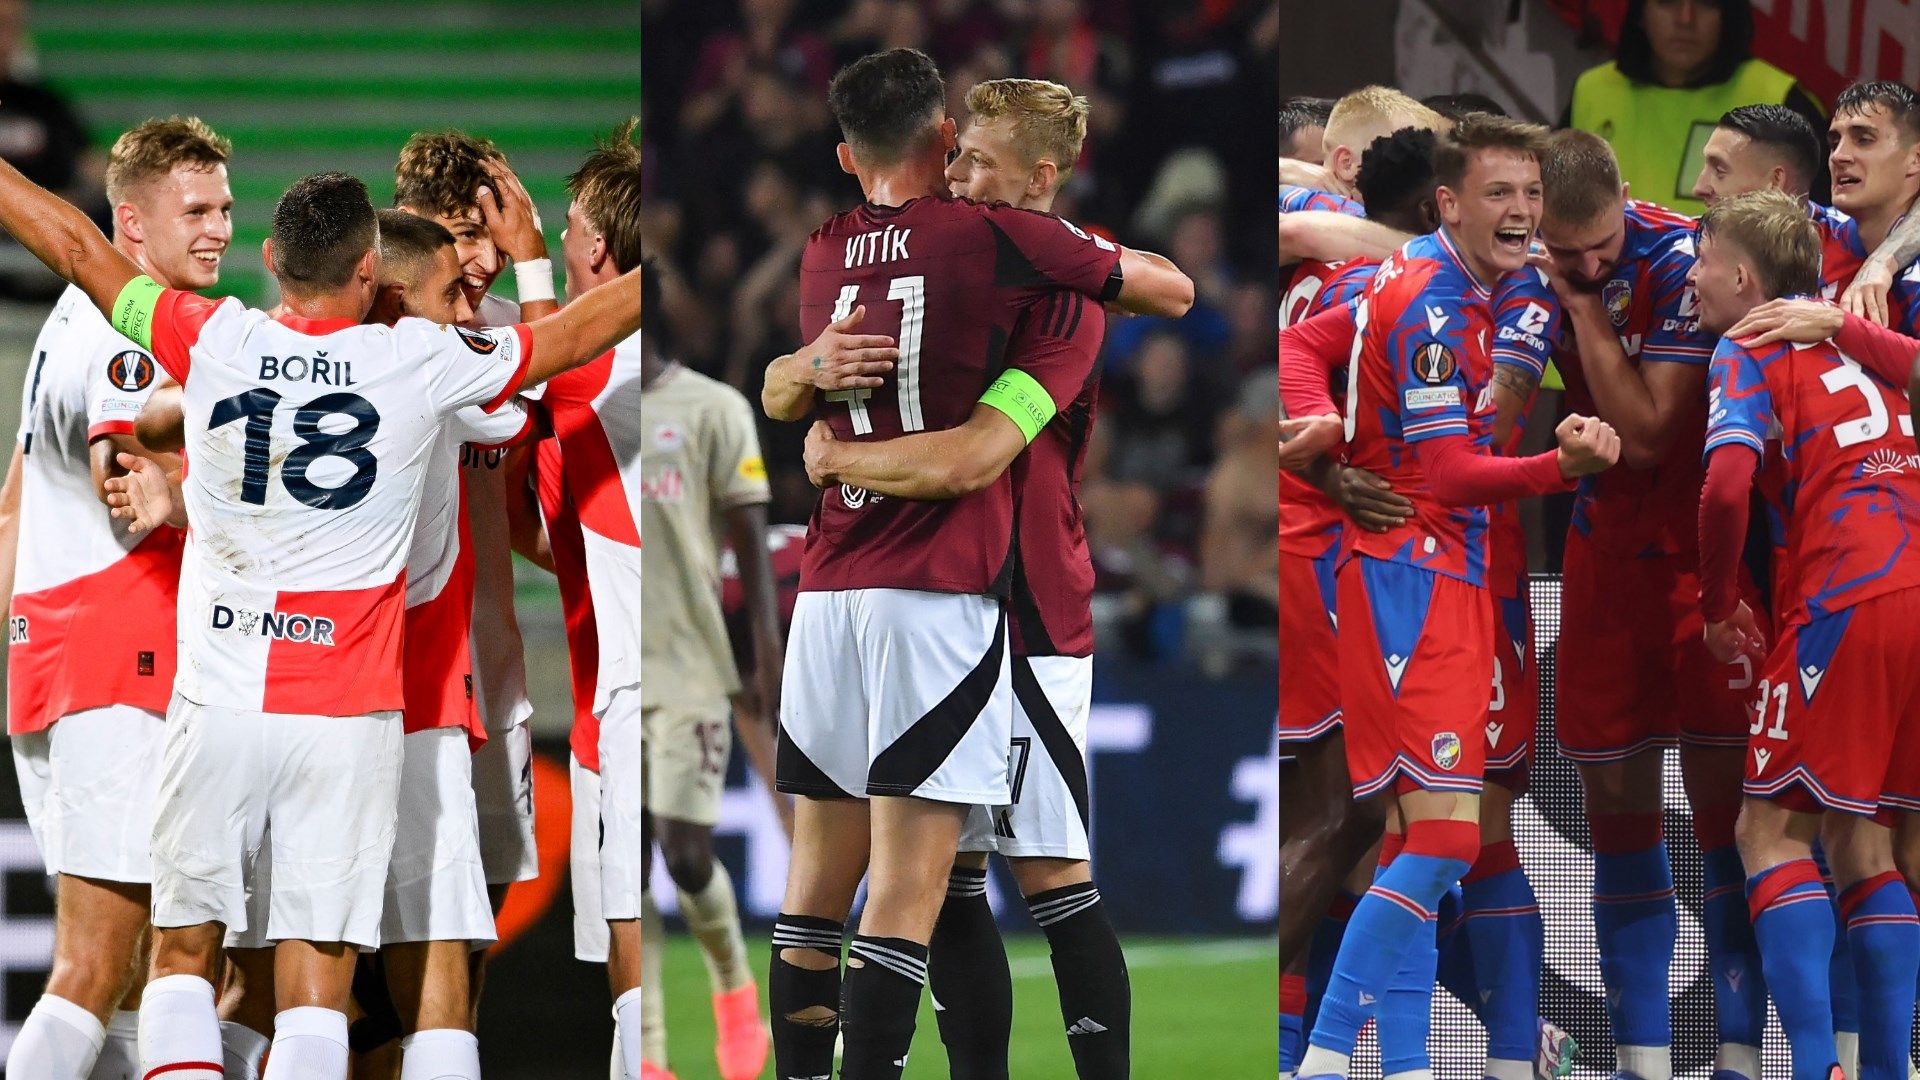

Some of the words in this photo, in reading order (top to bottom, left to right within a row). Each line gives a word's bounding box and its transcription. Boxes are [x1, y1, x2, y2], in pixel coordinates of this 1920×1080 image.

[844, 224, 912, 269] VITÍK
[132, 309, 146, 344] ESPECT
[1498, 326, 1545, 352] Betano
[1662, 318, 1699, 333] Beta
[258, 350, 358, 387] BOŘIL
[207, 387, 381, 511] 18
[1749, 678, 1789, 741] 31
